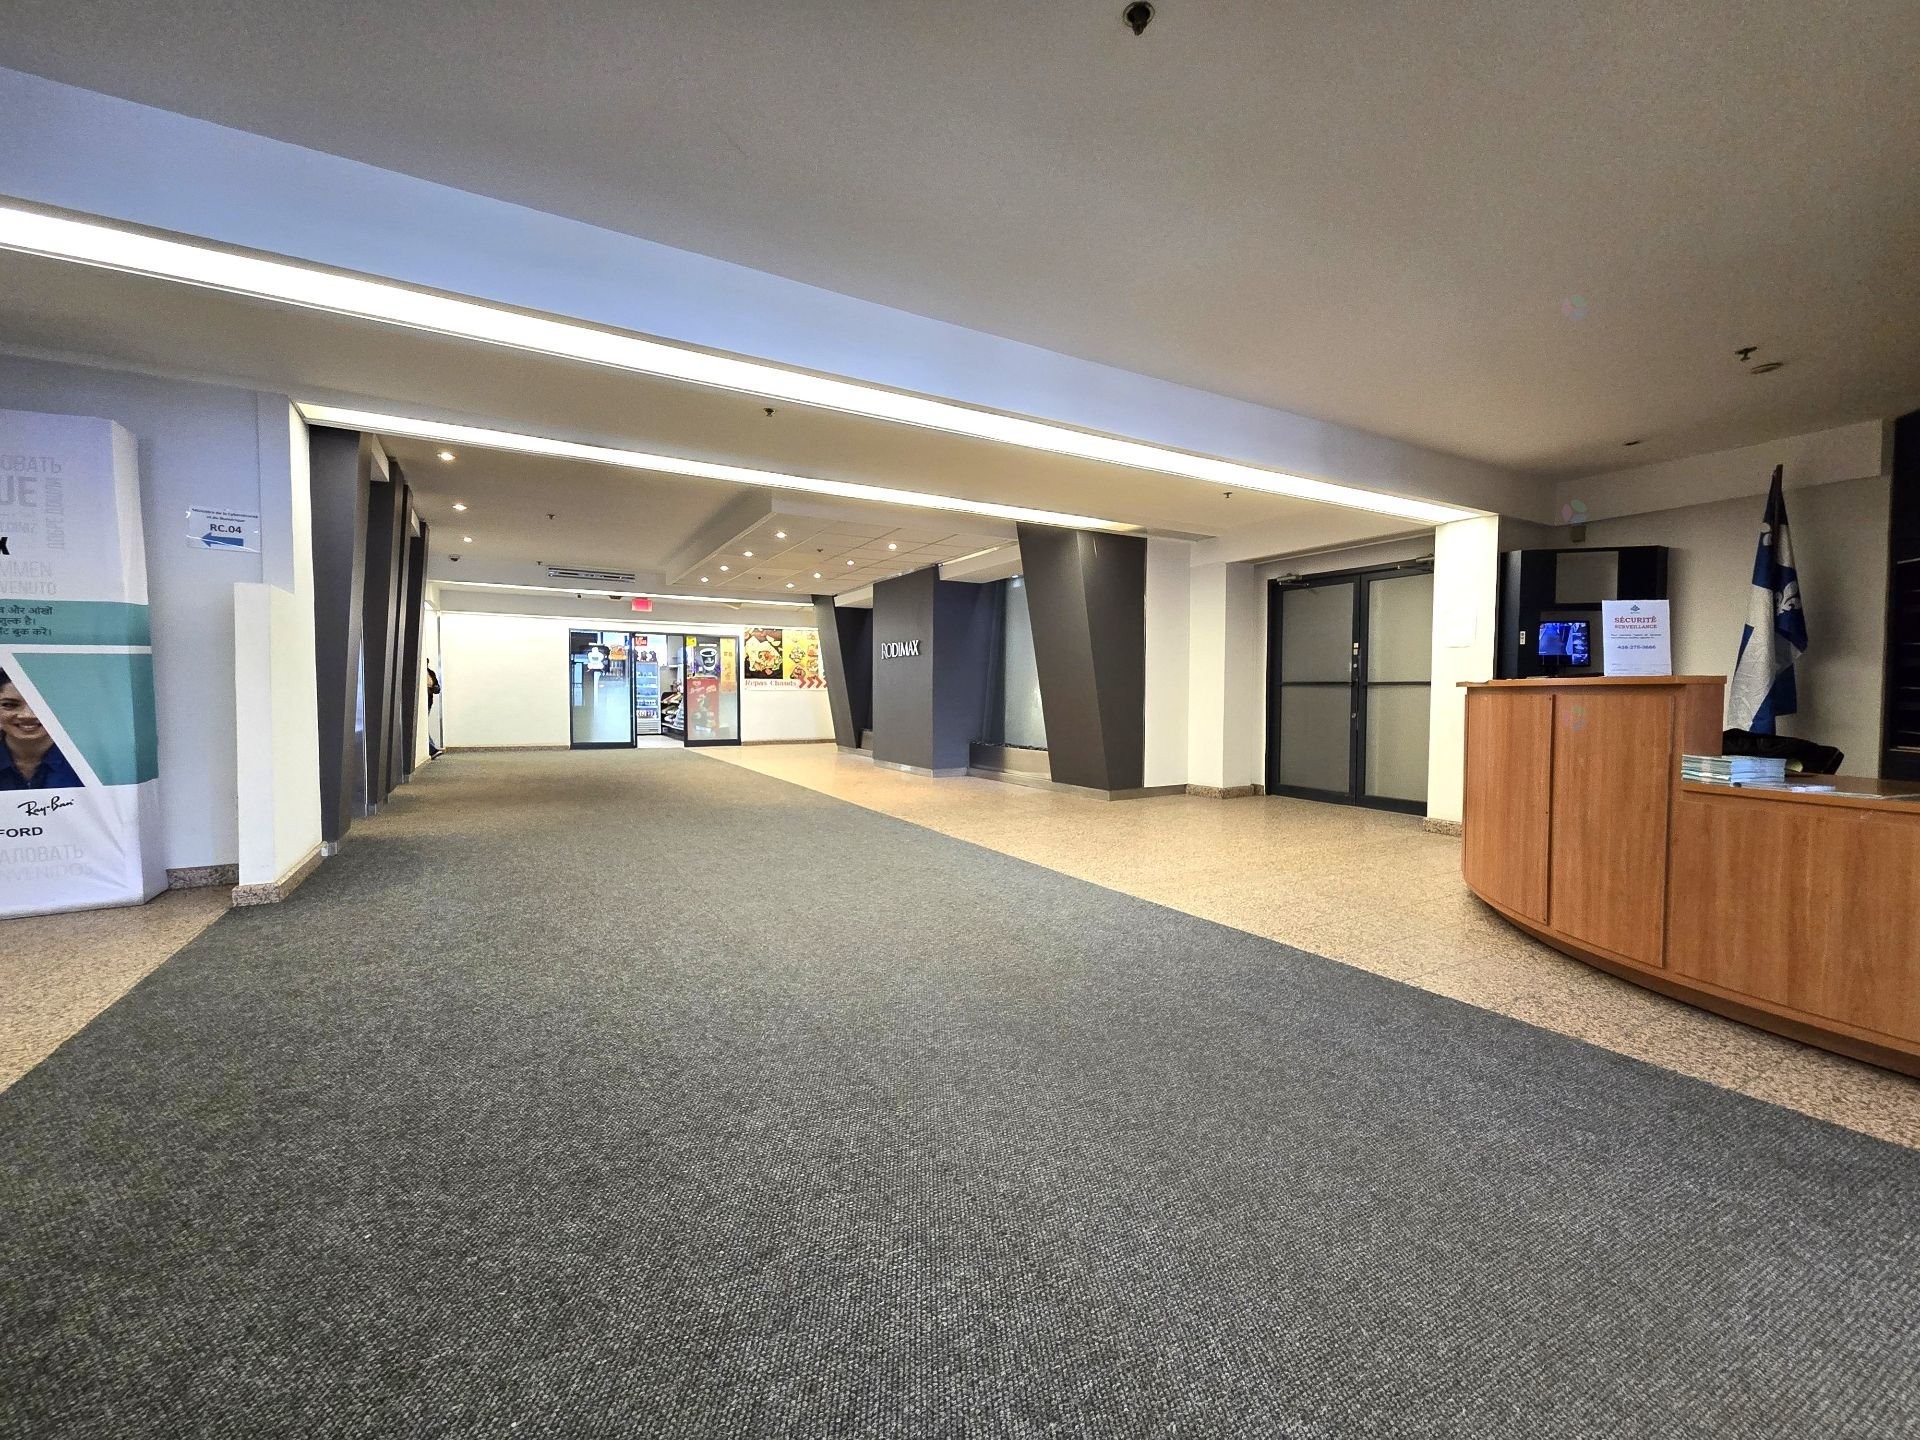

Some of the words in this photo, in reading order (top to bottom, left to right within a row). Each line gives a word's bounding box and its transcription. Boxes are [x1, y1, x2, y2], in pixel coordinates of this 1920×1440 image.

[210, 523, 242, 534] RC.04
[1614, 615, 1657, 624] SÉCURITÉ
[881, 640, 919, 660] RODIMAX
[17, 796, 74, 816] Ray-Ban
